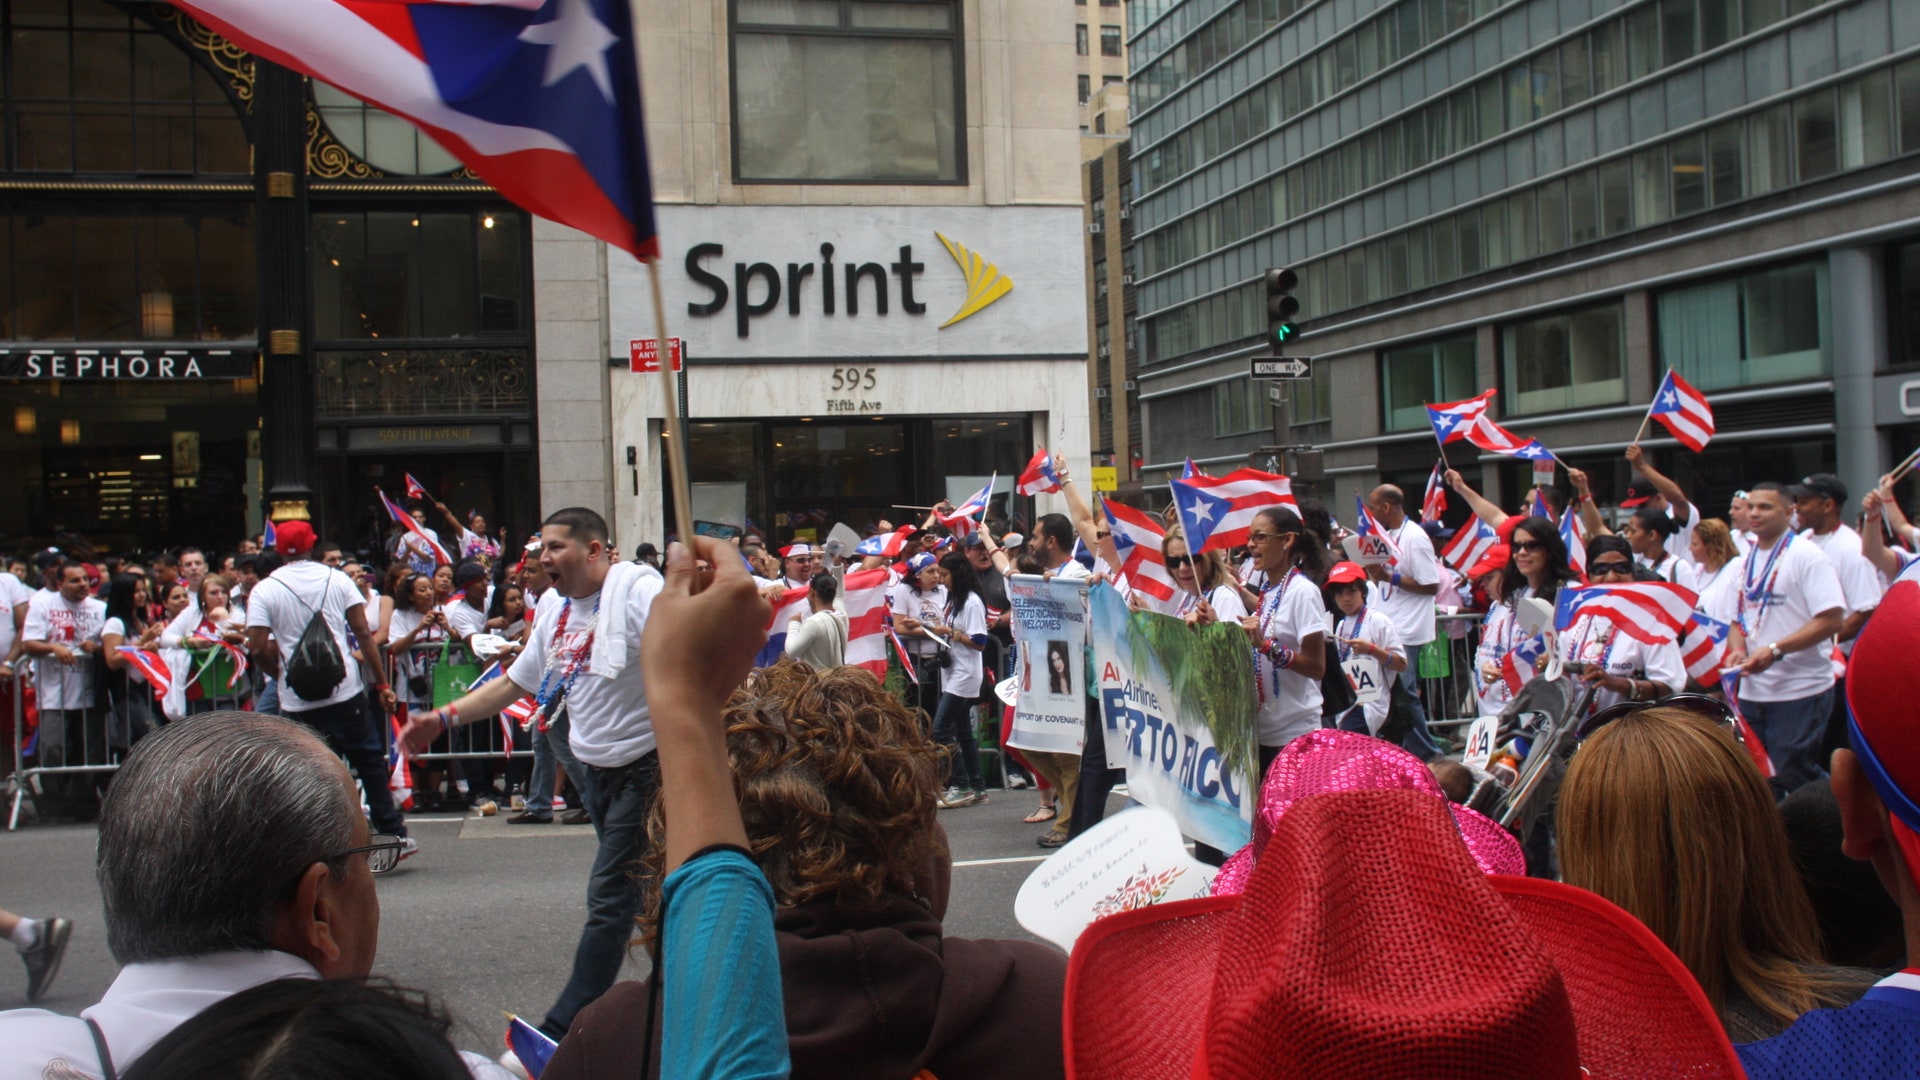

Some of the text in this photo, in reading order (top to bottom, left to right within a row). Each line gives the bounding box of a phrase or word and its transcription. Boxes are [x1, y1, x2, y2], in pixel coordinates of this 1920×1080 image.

[684, 241, 927, 338] Sprint
[632, 341, 643, 350] NO
[26, 354, 202, 378] SEPHORA
[1259, 363, 1303, 373] ONE WAY
[831, 367, 877, 391] 595
[826, 399, 882, 412] Fifth Ave
[379, 427, 473, 442] 597 FIFTH AVENUE
[1023, 619, 1062, 630] WELCOMES
[1016, 711, 1035, 720] UPPORT
[1035, 714, 1043, 722] OF
[1044, 714, 1079, 725] COVENANT
[1102, 688, 1178, 772] PRTO
